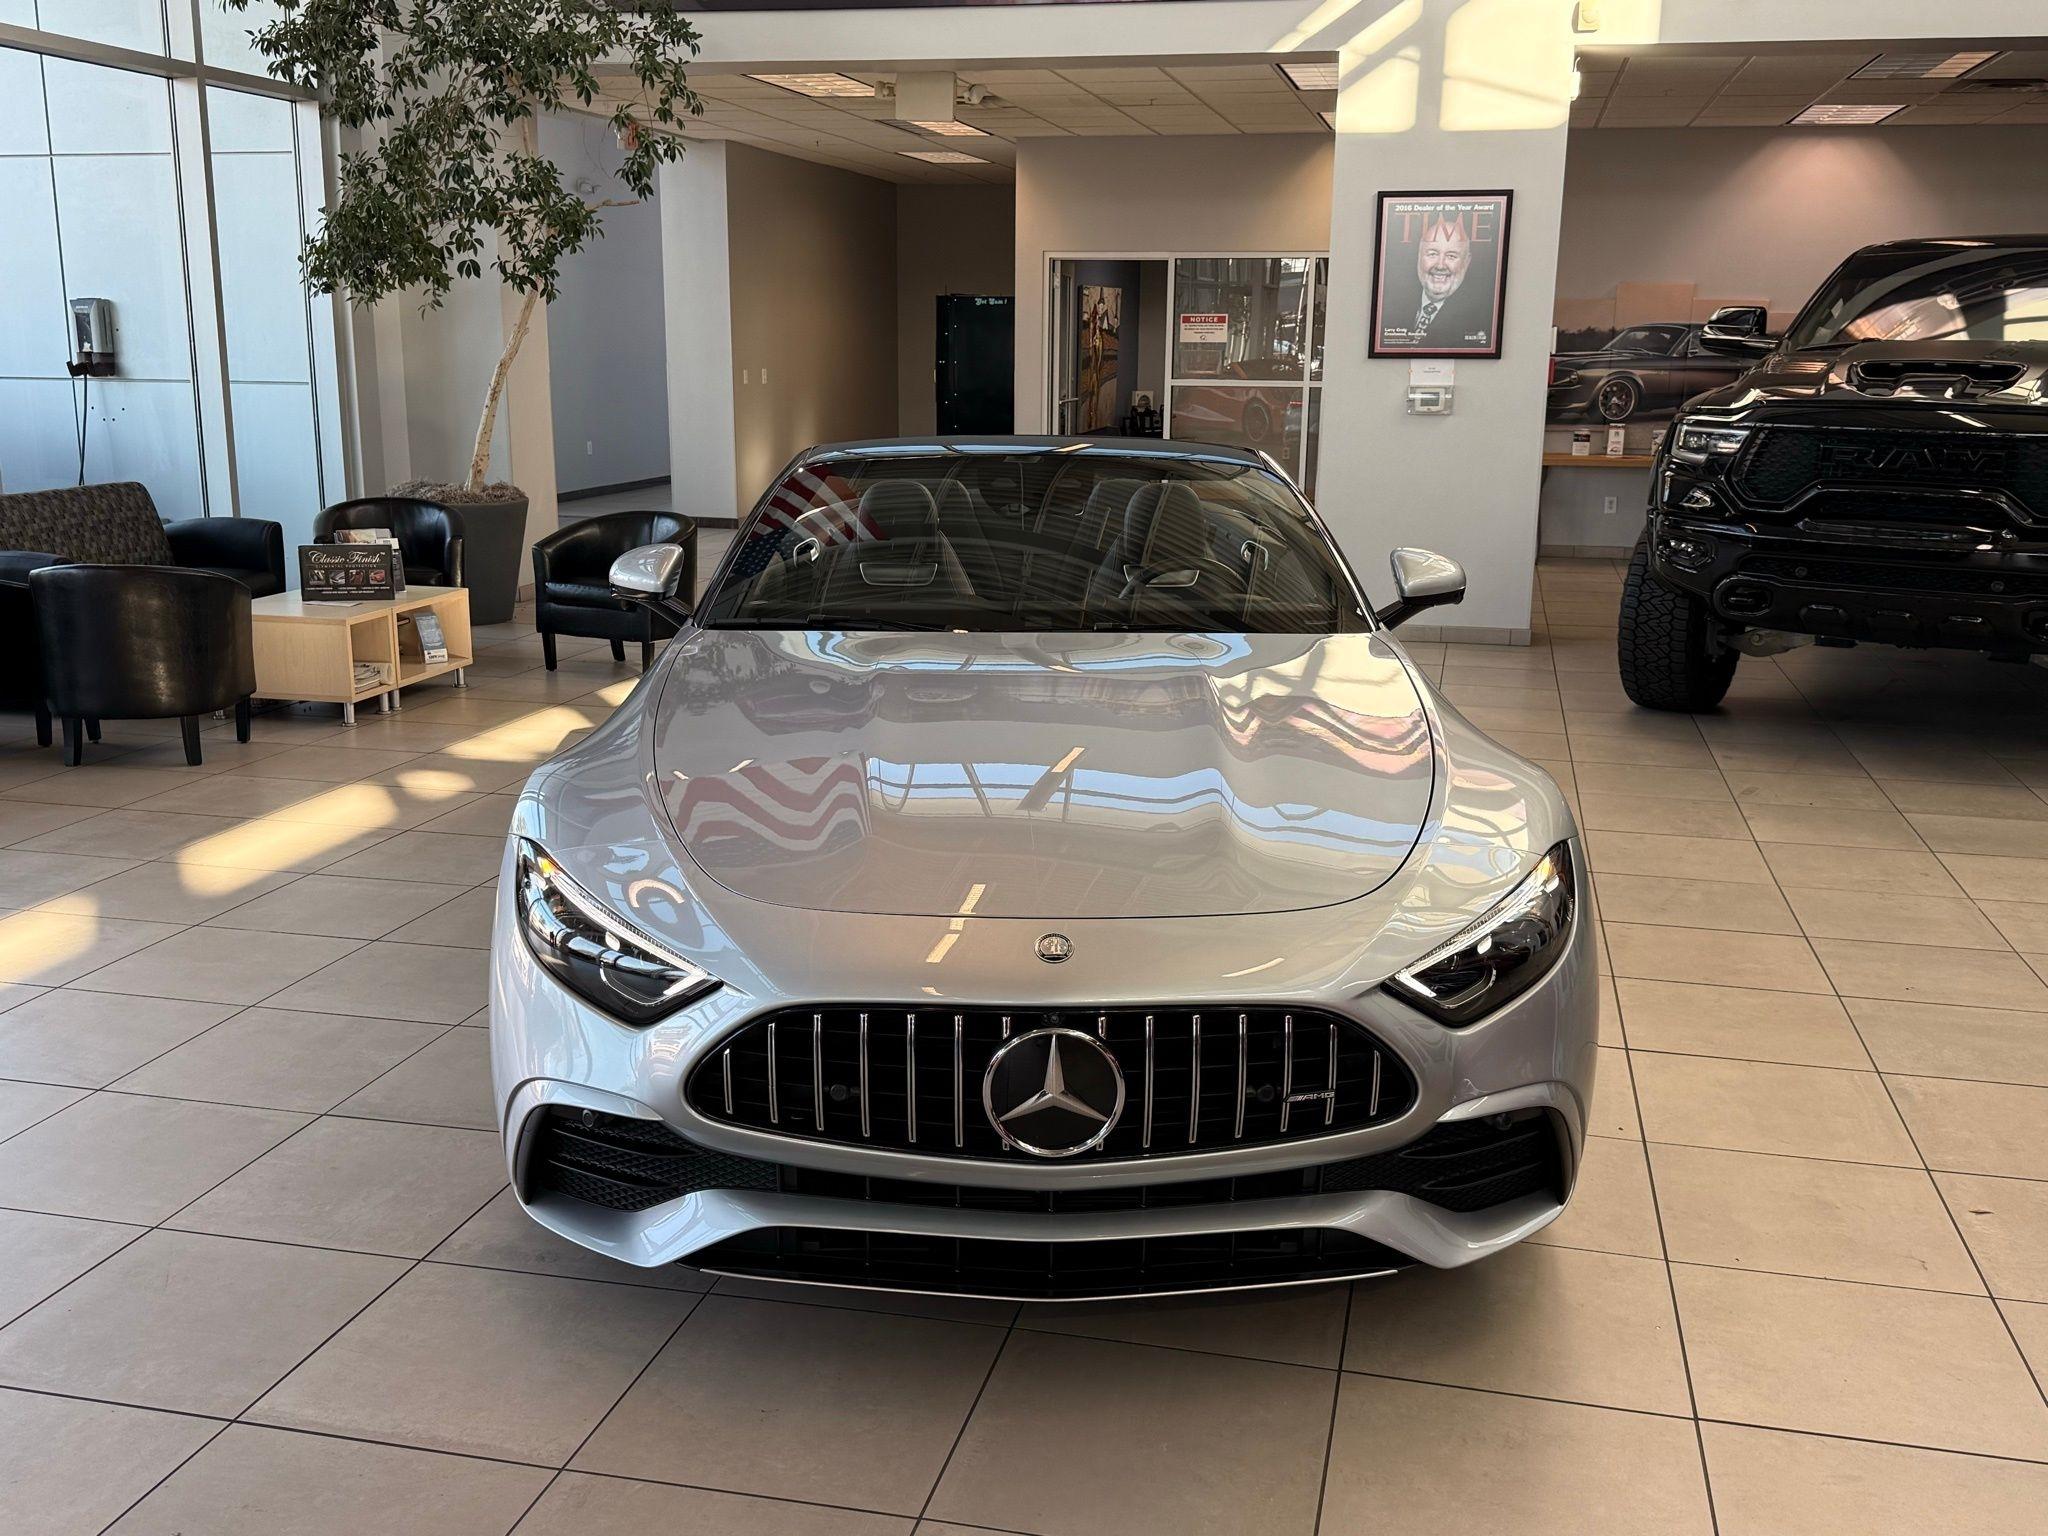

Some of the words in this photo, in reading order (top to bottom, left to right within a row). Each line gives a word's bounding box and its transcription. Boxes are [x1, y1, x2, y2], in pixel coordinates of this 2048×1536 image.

[1396, 211, 1493, 243] TIME
[308, 551, 345, 564] Classic
[347, 551, 381, 563] Finish
[1302, 1091, 1335, 1101] AMG
